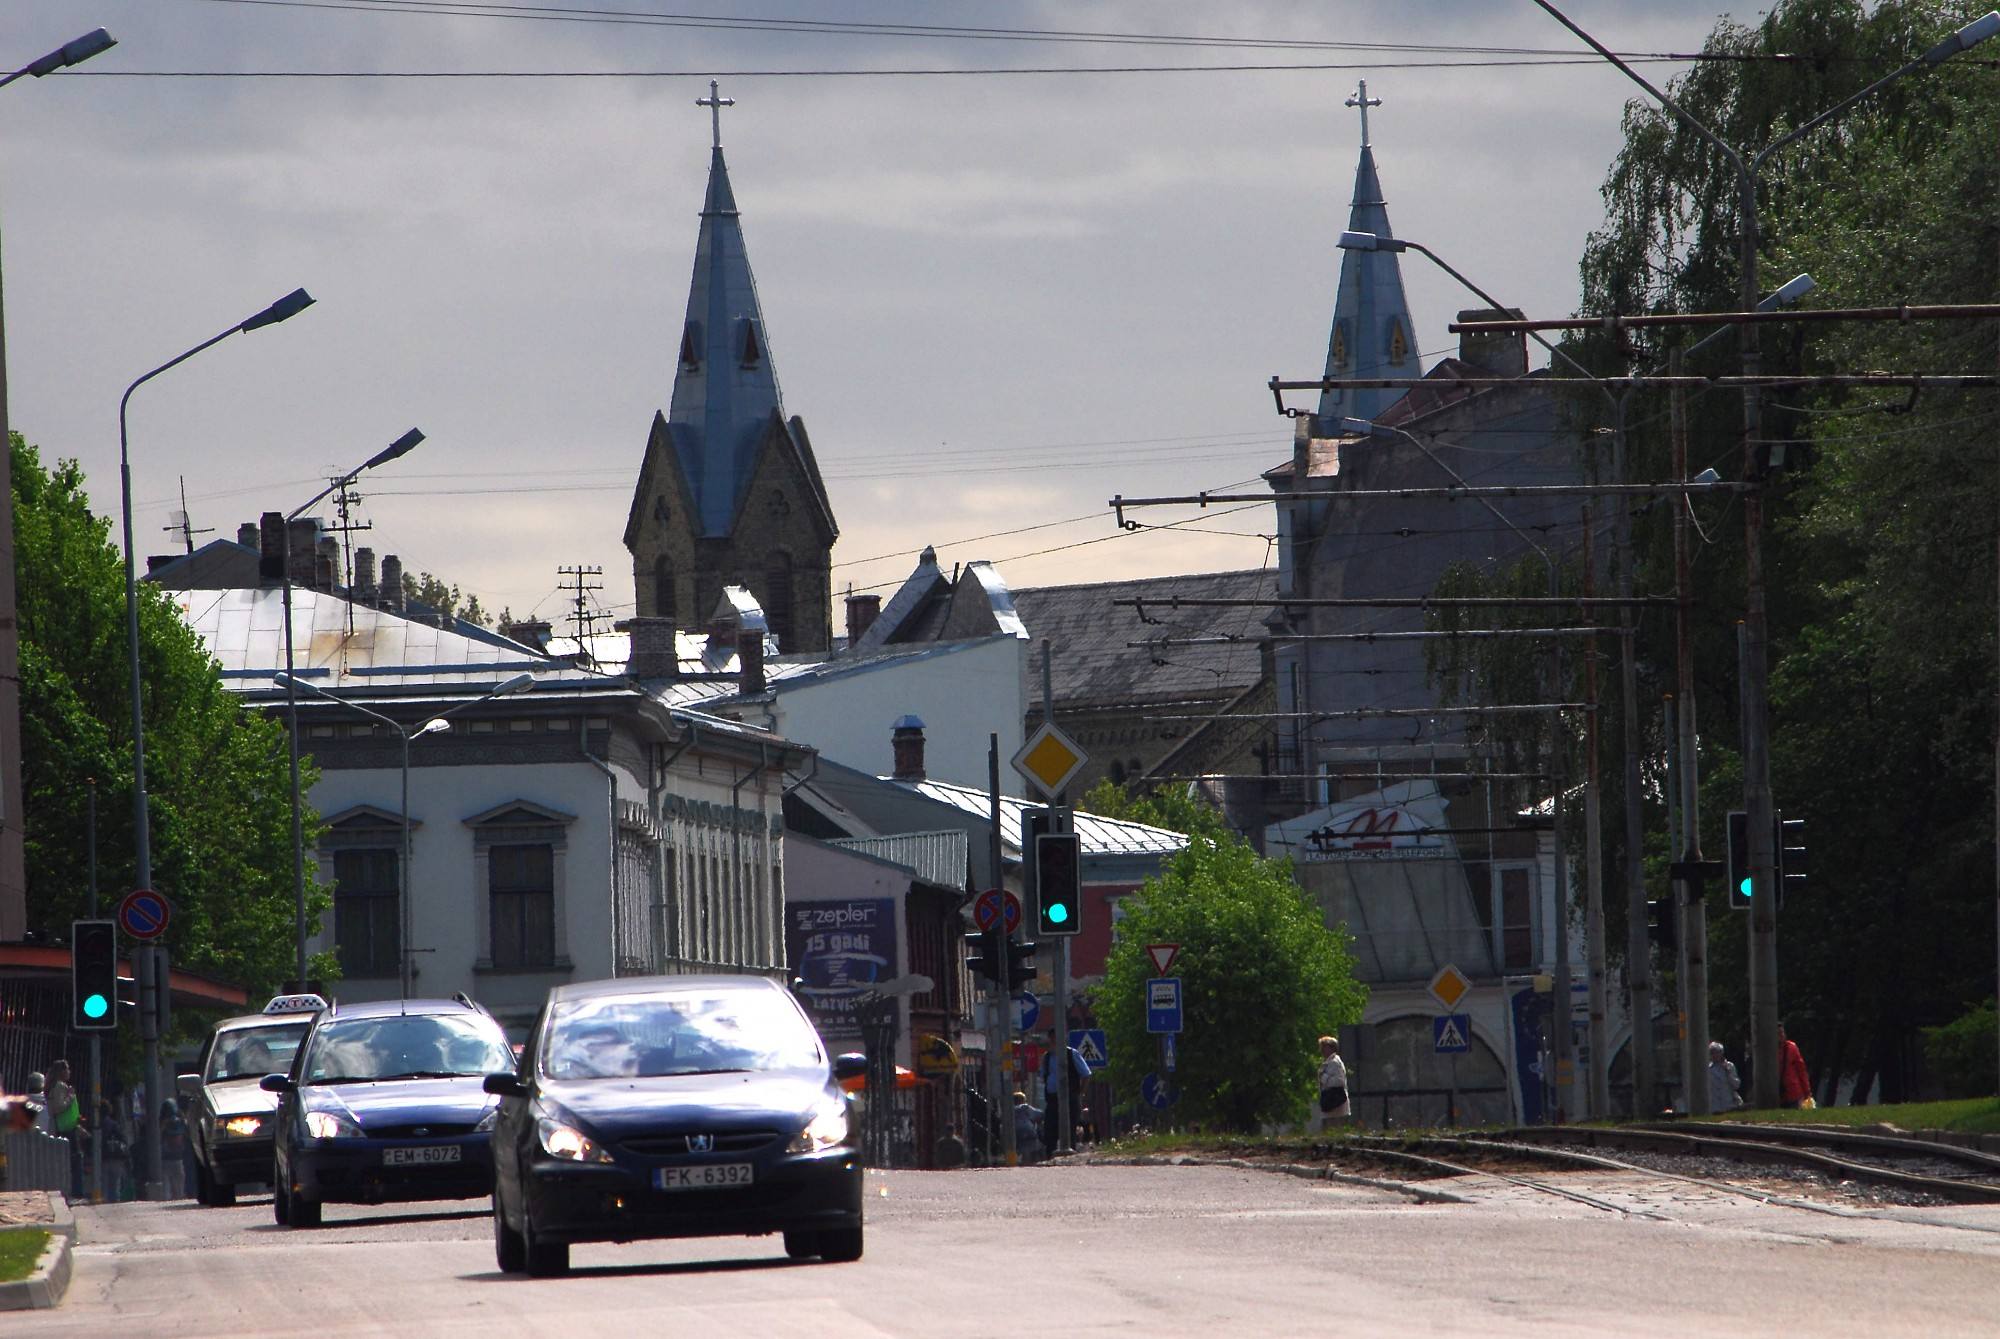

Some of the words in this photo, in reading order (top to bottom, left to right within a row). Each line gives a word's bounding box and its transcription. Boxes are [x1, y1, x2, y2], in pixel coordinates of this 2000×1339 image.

[806, 934, 825, 951] 15
[830, 934, 870, 953] gadi
[393, 1147, 459, 1163] EM-6072
[664, 1166, 751, 1186] FK-6392
